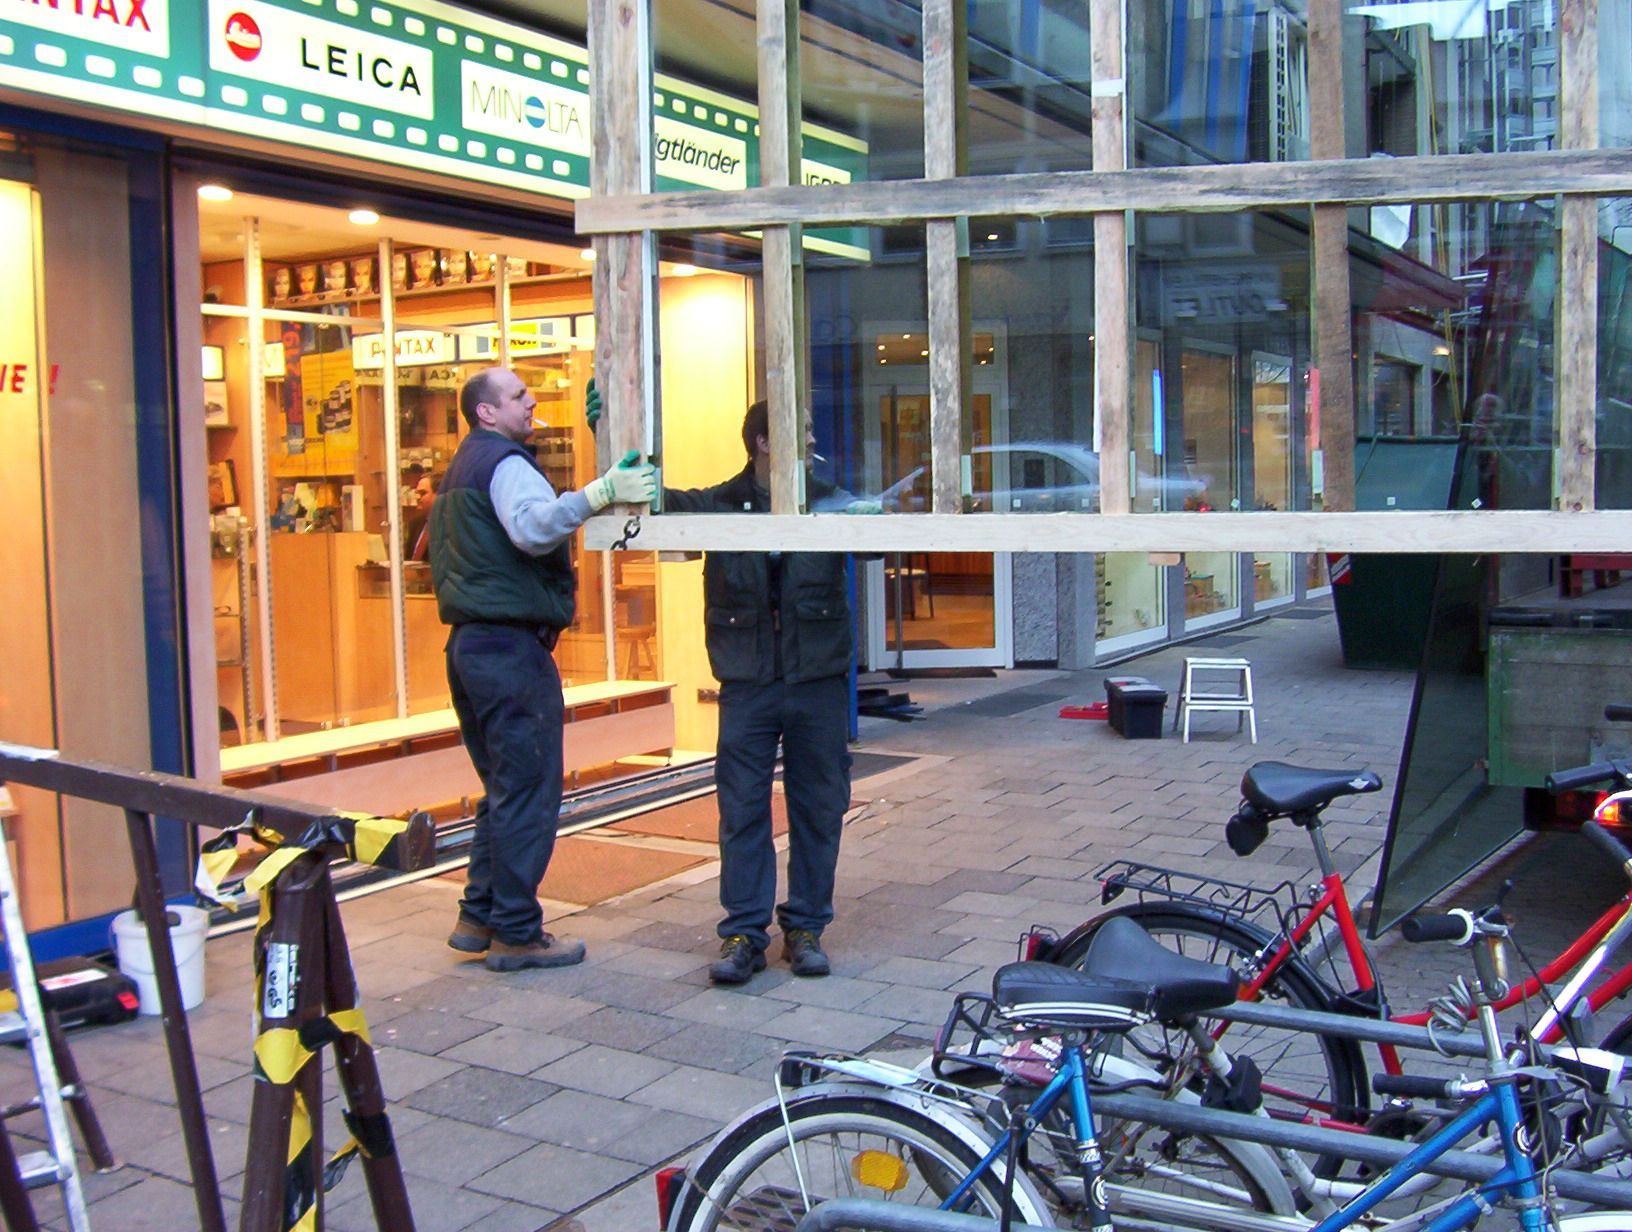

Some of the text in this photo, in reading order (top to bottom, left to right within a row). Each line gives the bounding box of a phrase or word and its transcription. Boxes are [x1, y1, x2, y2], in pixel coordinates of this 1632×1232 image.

[301, 37, 421, 96] LEICA
[471, 80, 584, 138] MINOLTA
[371, 337, 434, 357] PTAX
